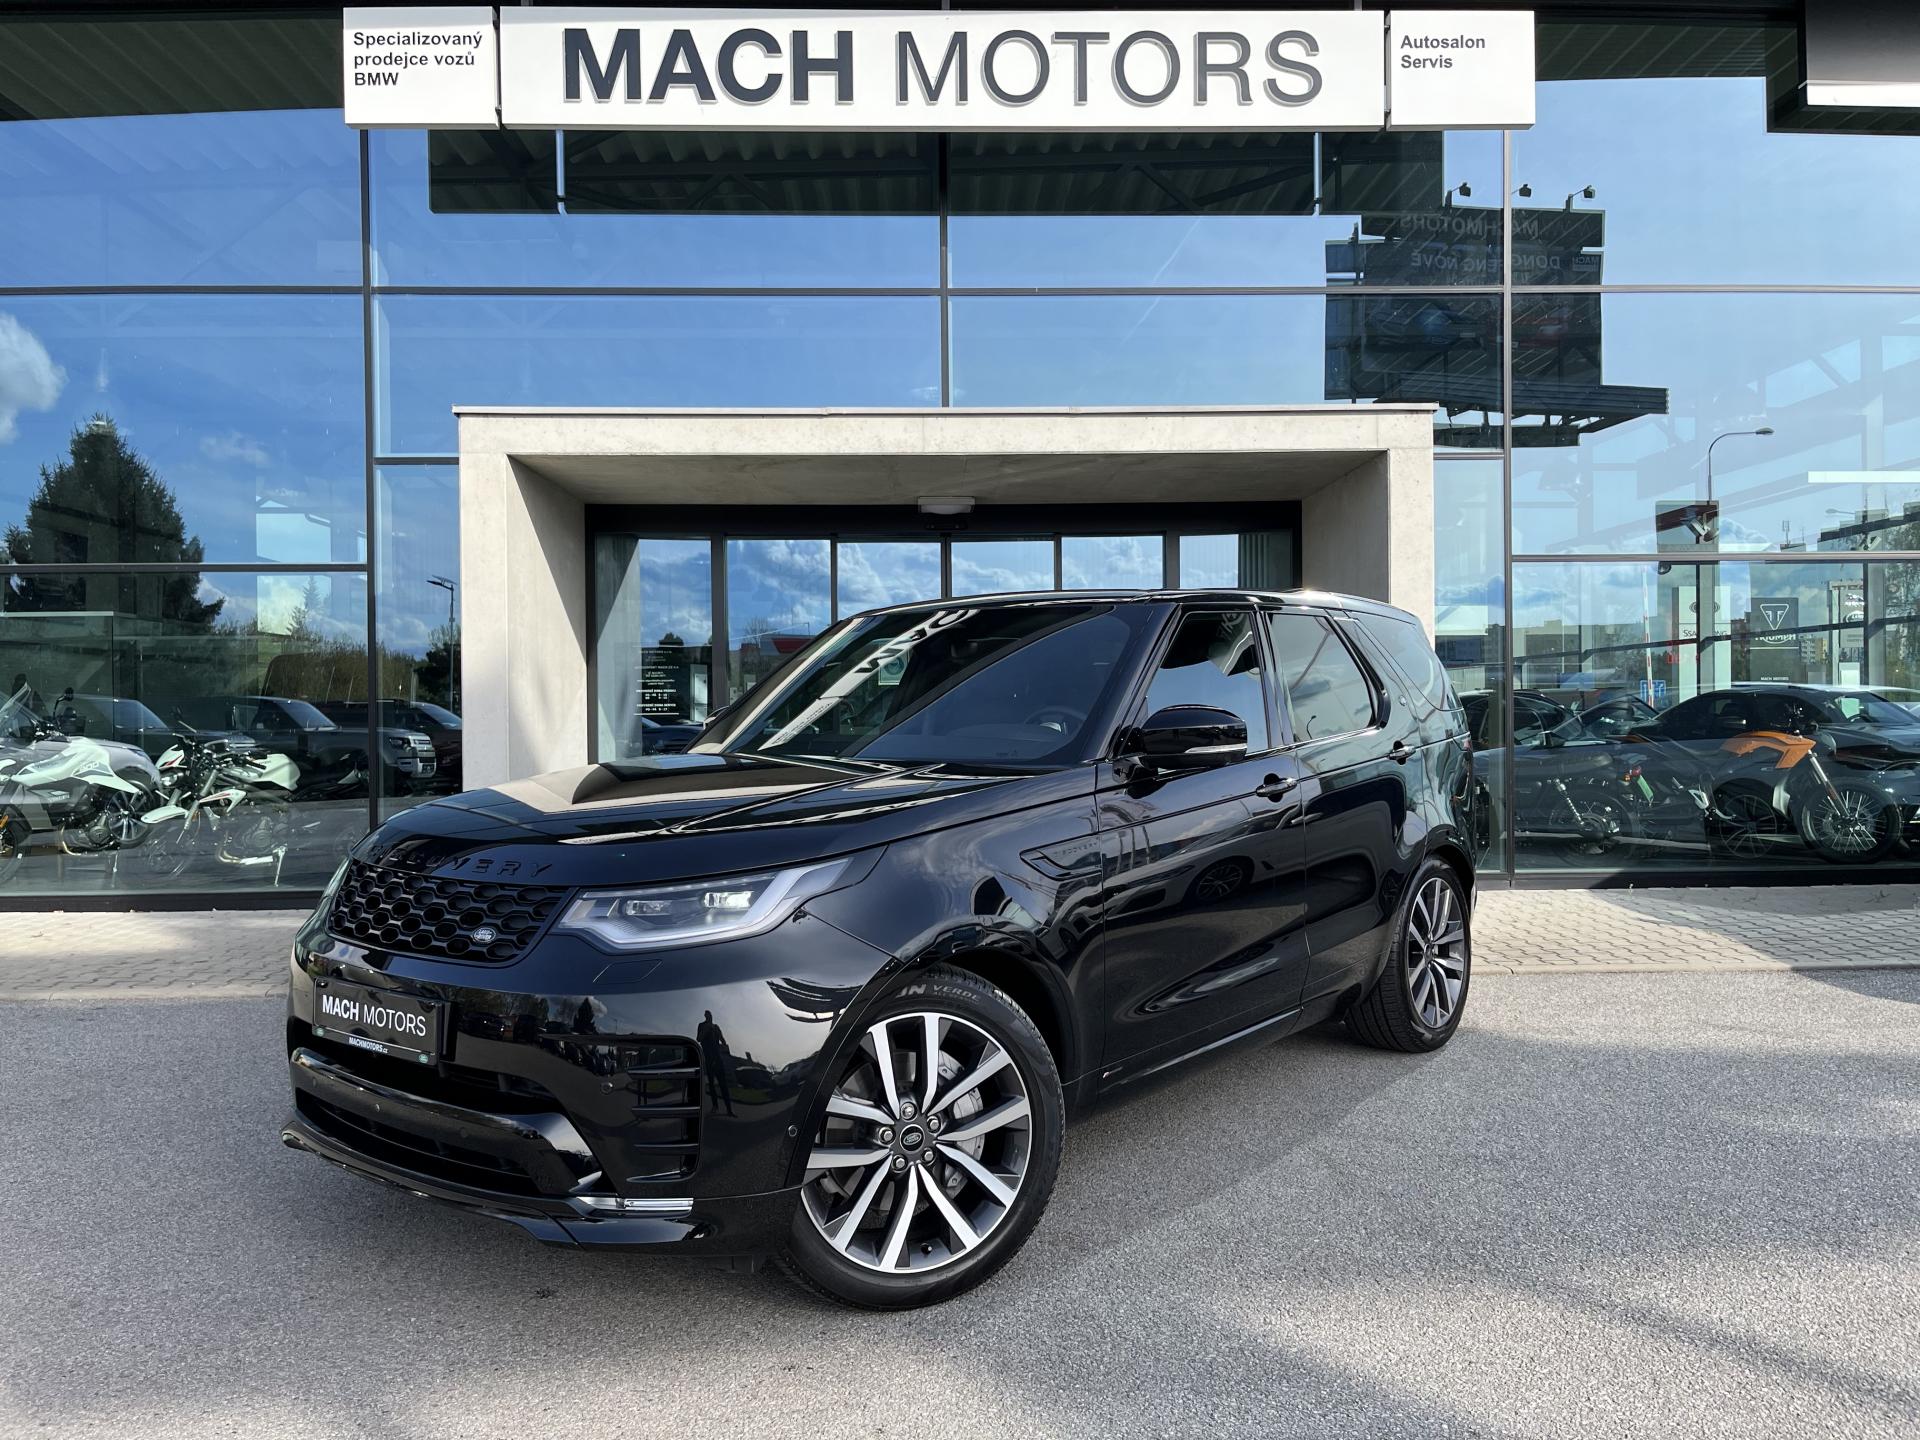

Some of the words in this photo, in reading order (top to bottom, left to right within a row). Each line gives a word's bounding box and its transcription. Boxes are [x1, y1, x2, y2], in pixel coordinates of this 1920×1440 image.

[353, 31, 482, 49] Specializovaný
[1400, 35, 1486, 49] Autosalon
[354, 52, 428, 69] prodejce
[434, 51, 475, 66] vozů
[563, 28, 854, 104] MACH
[895, 29, 1323, 107] MOTORS
[1400, 55, 1453, 69] Servis
[354, 72, 399, 86] BMW
[322, 994, 359, 1022] MACH
[363, 1004, 426, 1037] MOTORS
